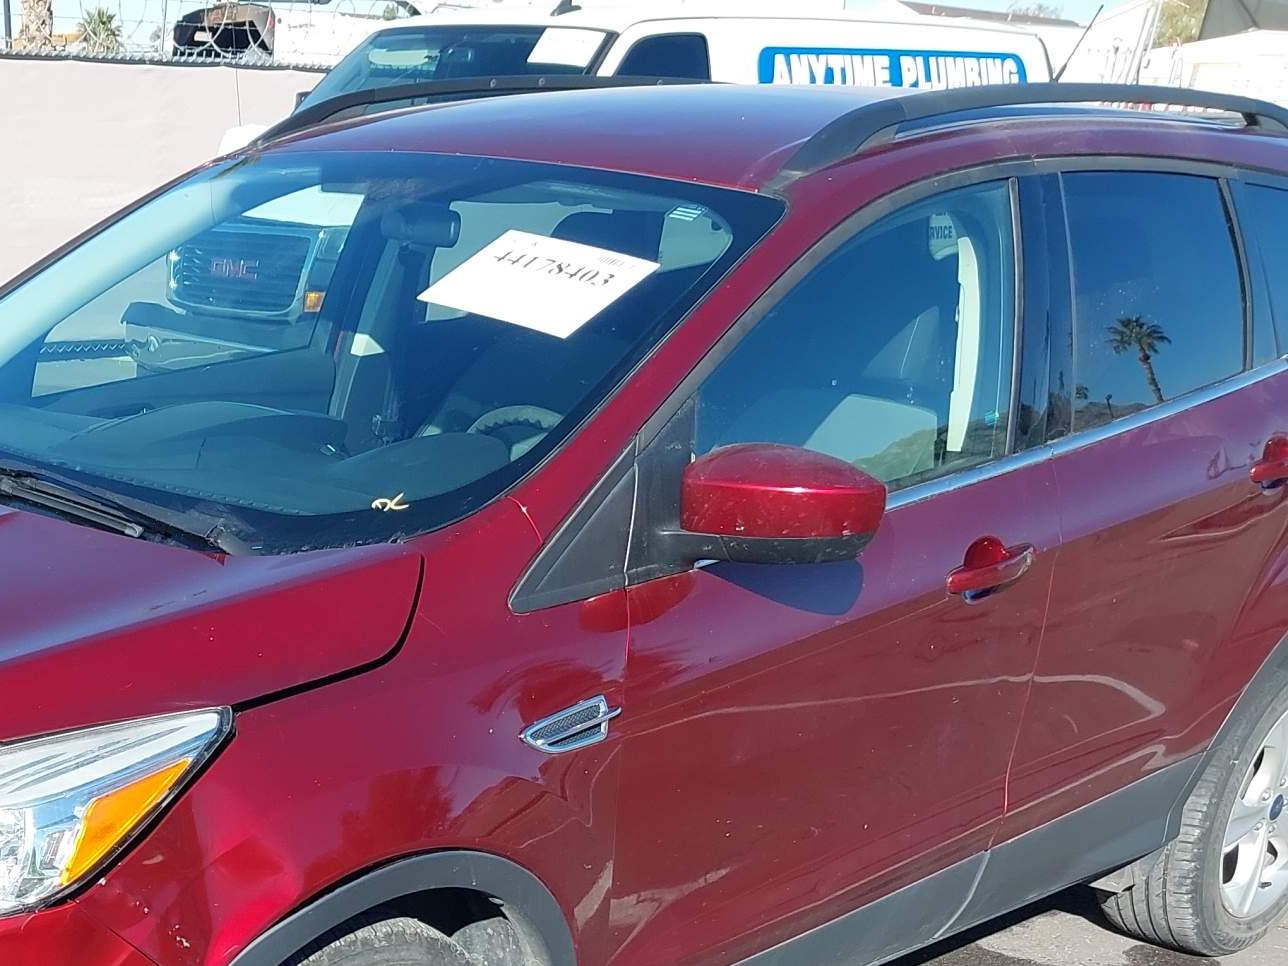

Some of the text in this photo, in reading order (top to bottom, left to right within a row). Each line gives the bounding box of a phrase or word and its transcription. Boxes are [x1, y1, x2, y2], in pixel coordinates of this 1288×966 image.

[773, 53, 1019, 89] ANYTIME PLUMBING
[493, 250, 616, 287] 44178403
